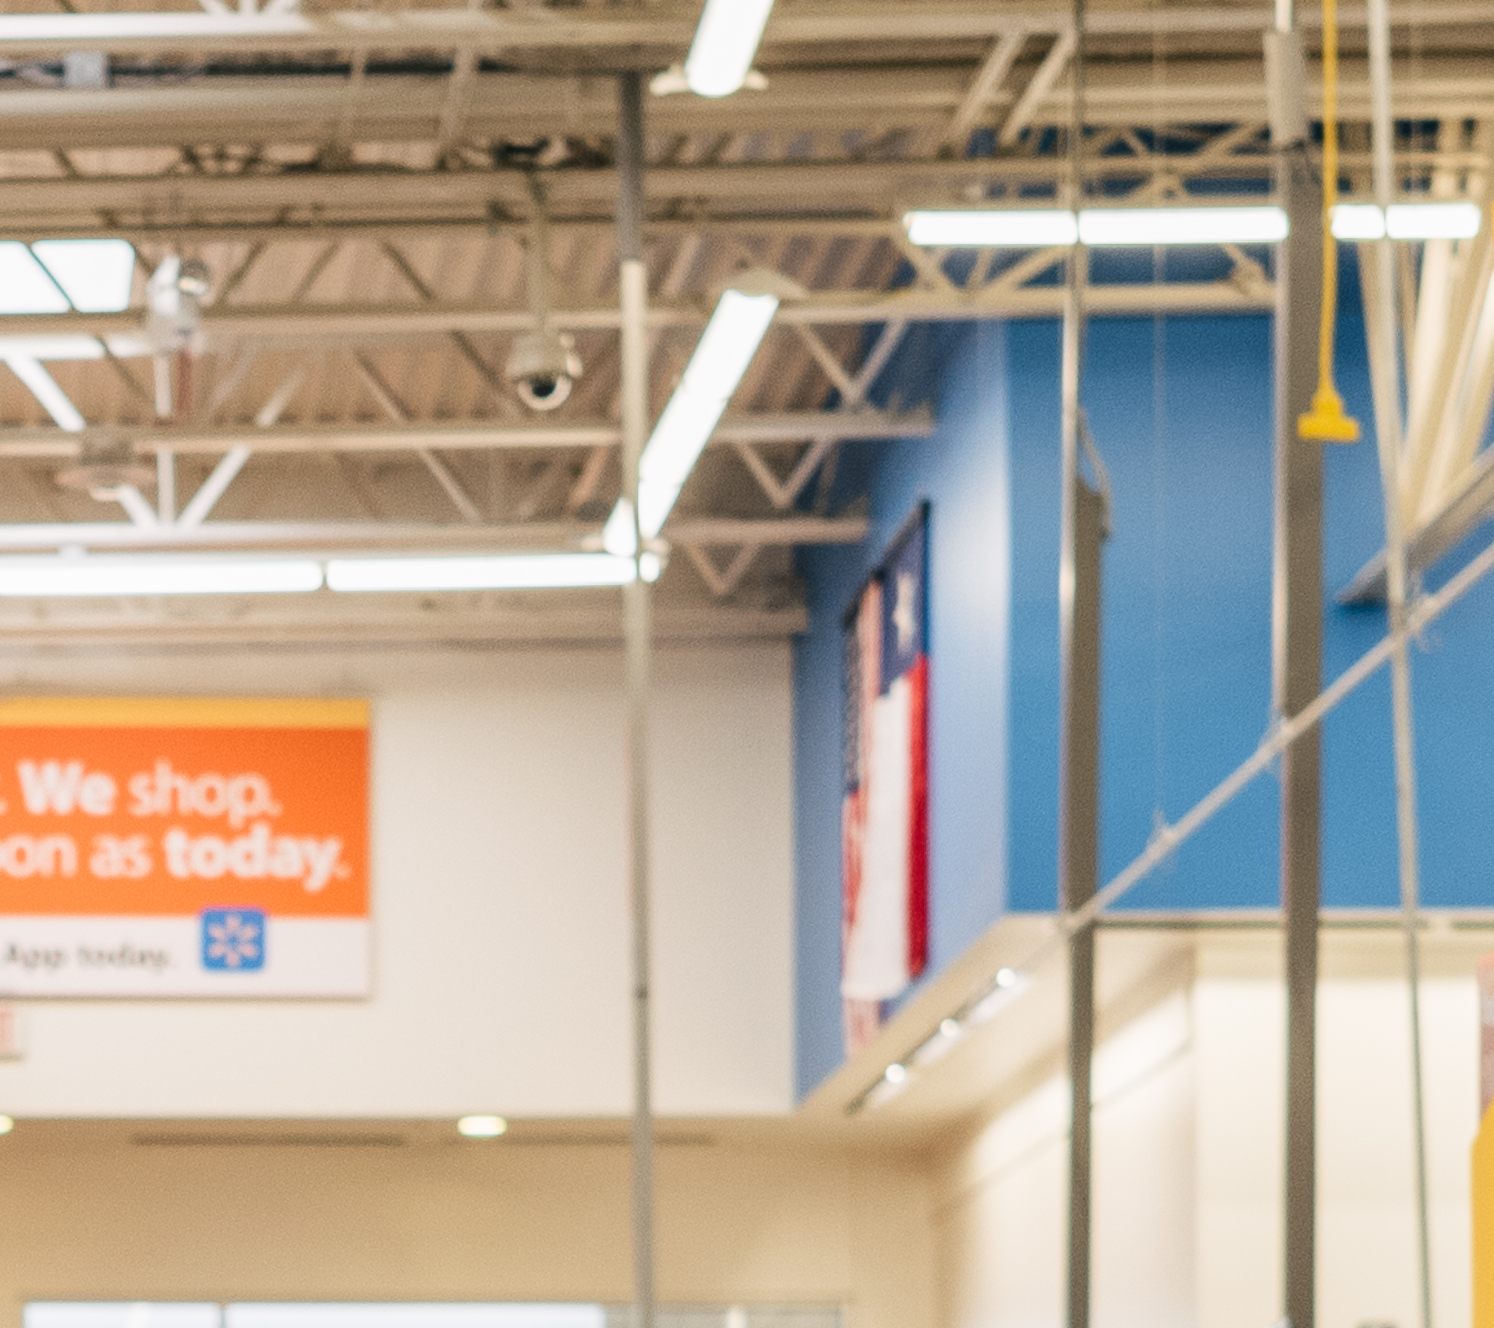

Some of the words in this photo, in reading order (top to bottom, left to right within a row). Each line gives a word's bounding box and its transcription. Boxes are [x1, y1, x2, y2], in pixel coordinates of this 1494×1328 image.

[18, 758, 116, 817] We
[128, 758, 282, 829] shop.
[90, 830, 151, 877] as
[164, 822, 351, 892] today.
